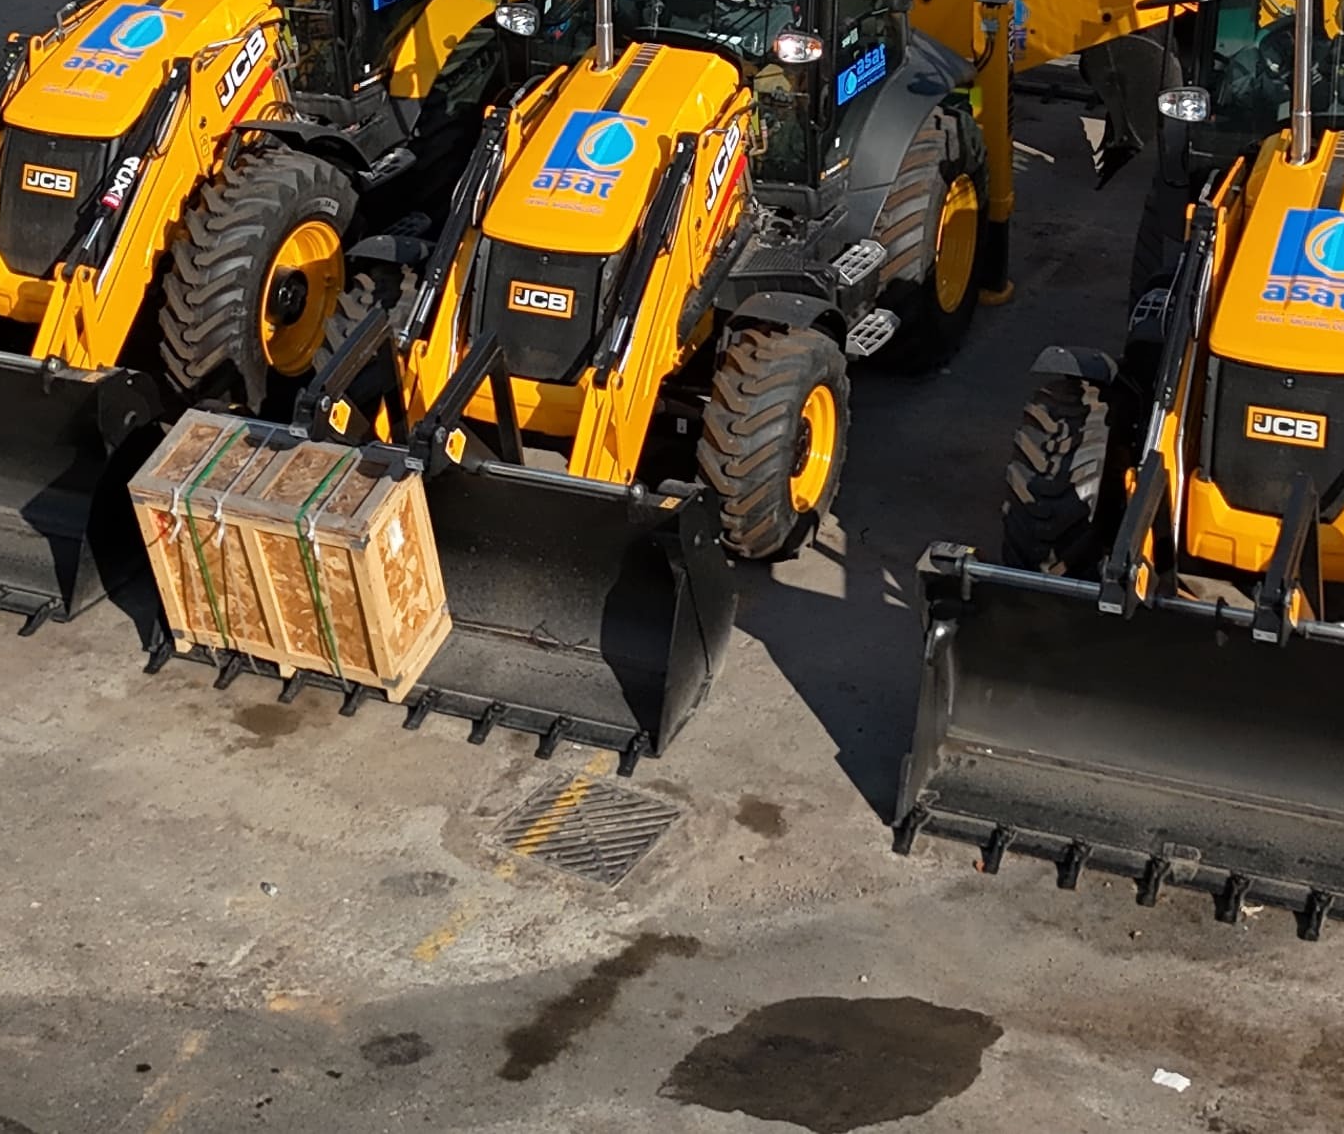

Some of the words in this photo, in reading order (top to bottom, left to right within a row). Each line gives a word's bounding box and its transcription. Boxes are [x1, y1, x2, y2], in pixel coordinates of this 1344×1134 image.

[63, 55, 130, 78] asat
[219, 29, 268, 107] JCB
[857, 42, 886, 75] asat
[706, 119, 742, 211] JCB
[26, 169, 72, 192] JCB
[532, 172, 613, 199] asat
[514, 288, 568, 312] JCB
[1253, 415, 1318, 440] JCB
